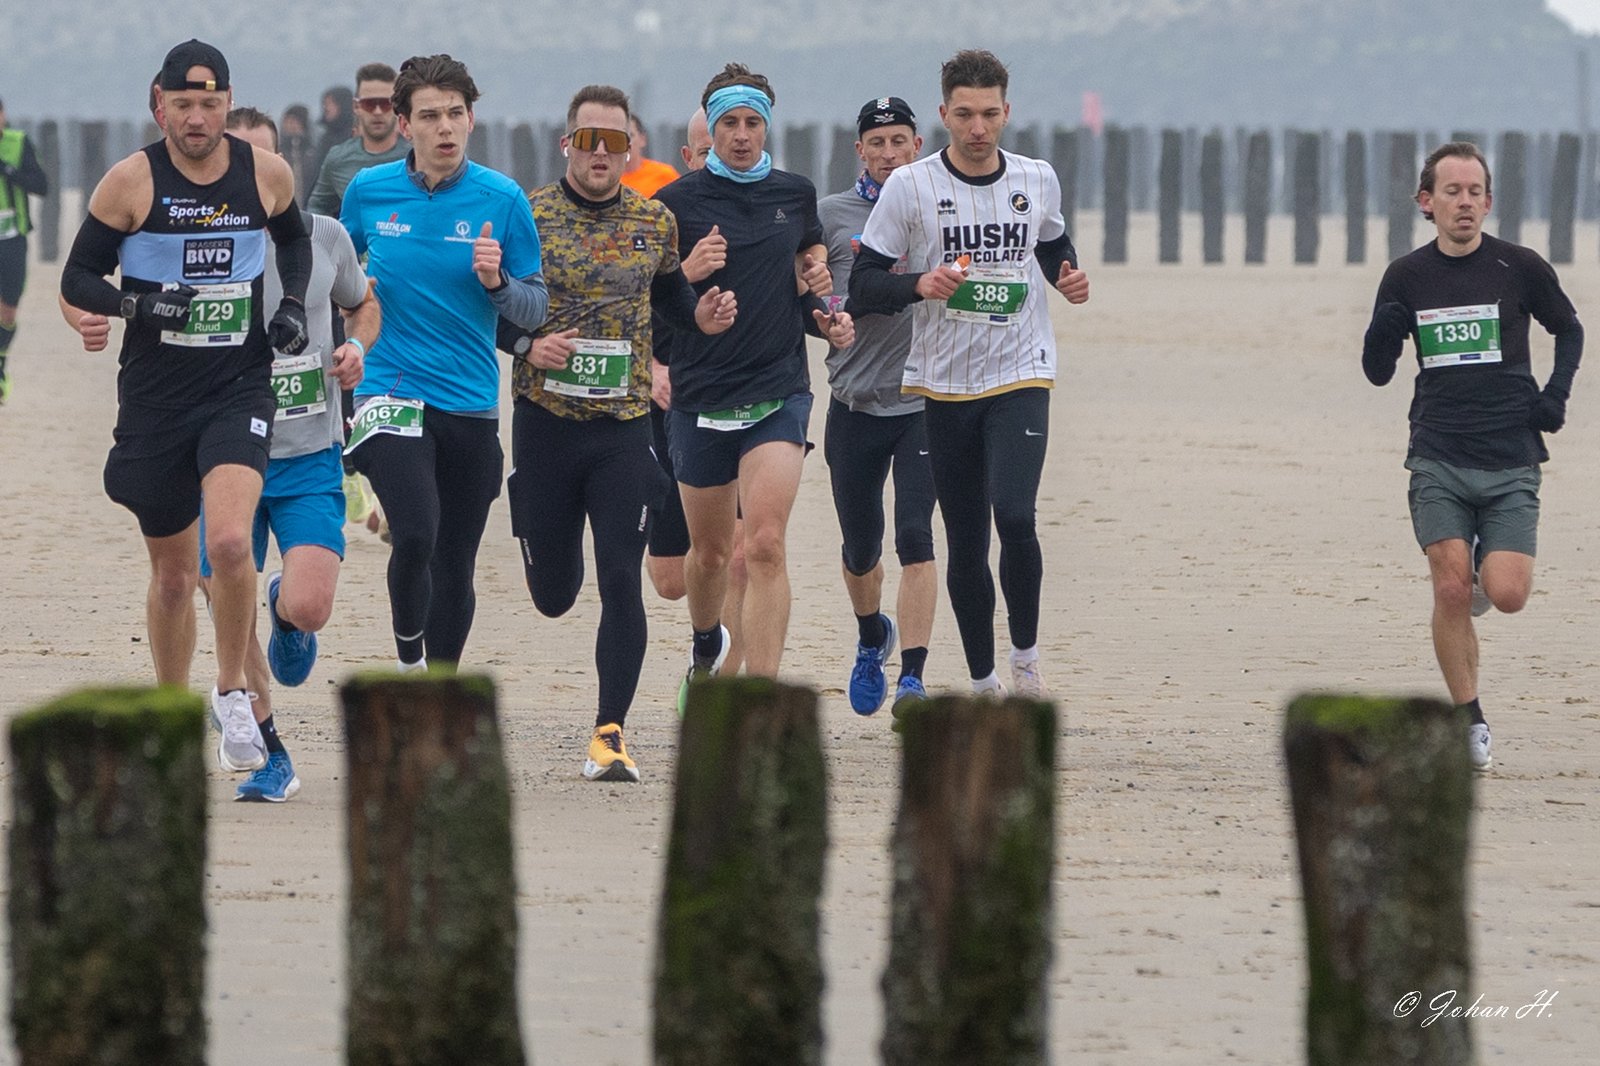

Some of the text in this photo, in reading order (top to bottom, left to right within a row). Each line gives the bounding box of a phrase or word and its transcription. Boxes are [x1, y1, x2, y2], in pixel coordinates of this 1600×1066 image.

[169, 205, 215, 219] Sports
[375, 221, 412, 233] TRIATHLON
[943, 223, 1028, 251] HUSKI
[186, 240, 232, 249] BRASSERIE
[186, 248, 231, 264] BLVD
[972, 284, 1009, 303] 388
[975, 302, 1003, 312] Kelvin
[194, 322, 220, 332] Ruud
[1434, 322, 1481, 343] 1330
[571, 355, 608, 375] 831
[578, 375, 600, 385] Paul
[360, 406, 404, 429] 1067
[734, 410, 751, 419] Tim
